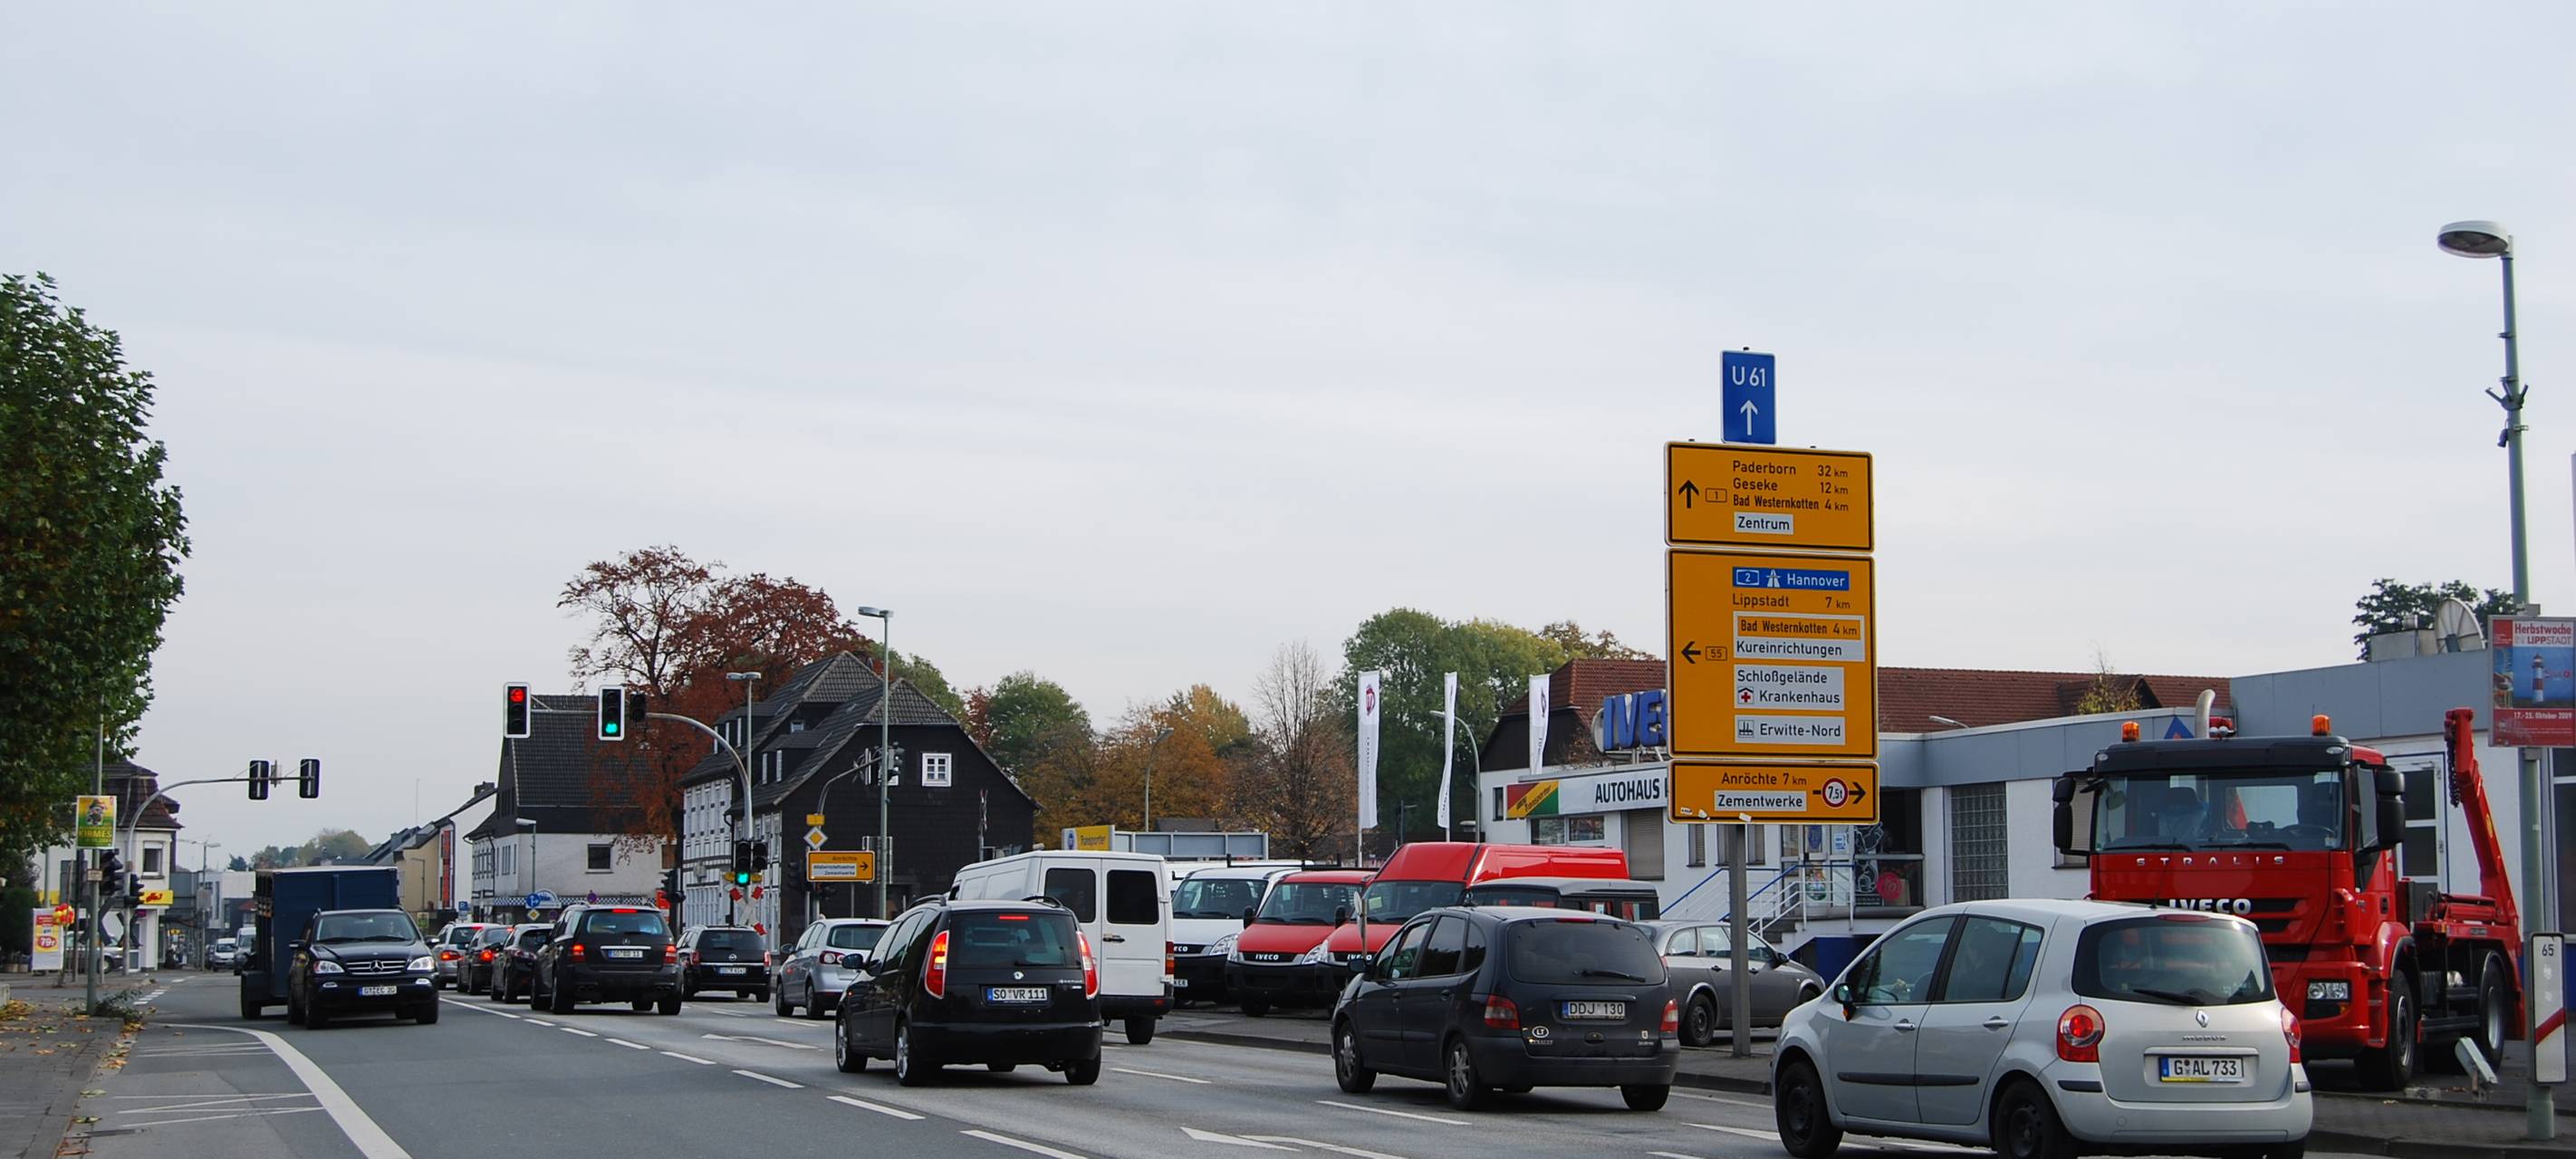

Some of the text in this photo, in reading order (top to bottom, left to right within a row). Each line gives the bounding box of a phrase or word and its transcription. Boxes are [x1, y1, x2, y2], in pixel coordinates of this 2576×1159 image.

[1732, 365, 1765, 388] U 61
[1732, 460, 1849, 478] Paderborn 32 km
[1733, 477, 1849, 495] Geseke 12 km
[1714, 491, 1719, 500] 1
[1733, 494, 1850, 512] Bad Westernkotten 4 km
[1737, 516, 1791, 531] Zentrum
[1745, 572, 1846, 588] 2 Hannover
[1732, 593, 1851, 609] Lippstadt 7 km
[1740, 619, 1858, 636] Bad Westernkotten 4 km
[2514, 622, 2572, 634] Herbstwoche
[2527, 636, 2572, 645] LIPPSTADT
[1710, 648, 1723, 659] 55
[1735, 640, 1843, 658] Kureinrichtungen
[1736, 669, 1828, 685] Schloßgelände
[1759, 690, 1841, 704] Krankenhaus
[1603, 689, 1668, 751] IVE
[1759, 723, 1841, 736] Erwitte-Nord
[1721, 772, 1807, 786] Anröchte 7 km
[1594, 778, 1660, 805] AUTOHAUS
[1717, 794, 1803, 808] Zementwerke
[2136, 856, 2284, 867] STRALIS
[2168, 897, 2252, 915] IVECO
[2542, 943, 2554, 956] 65
[994, 989, 1046, 1000] SO VR 111
[1569, 1002, 1624, 1014] DDJ 130
[2174, 1059, 2237, 1076] G AL 733
